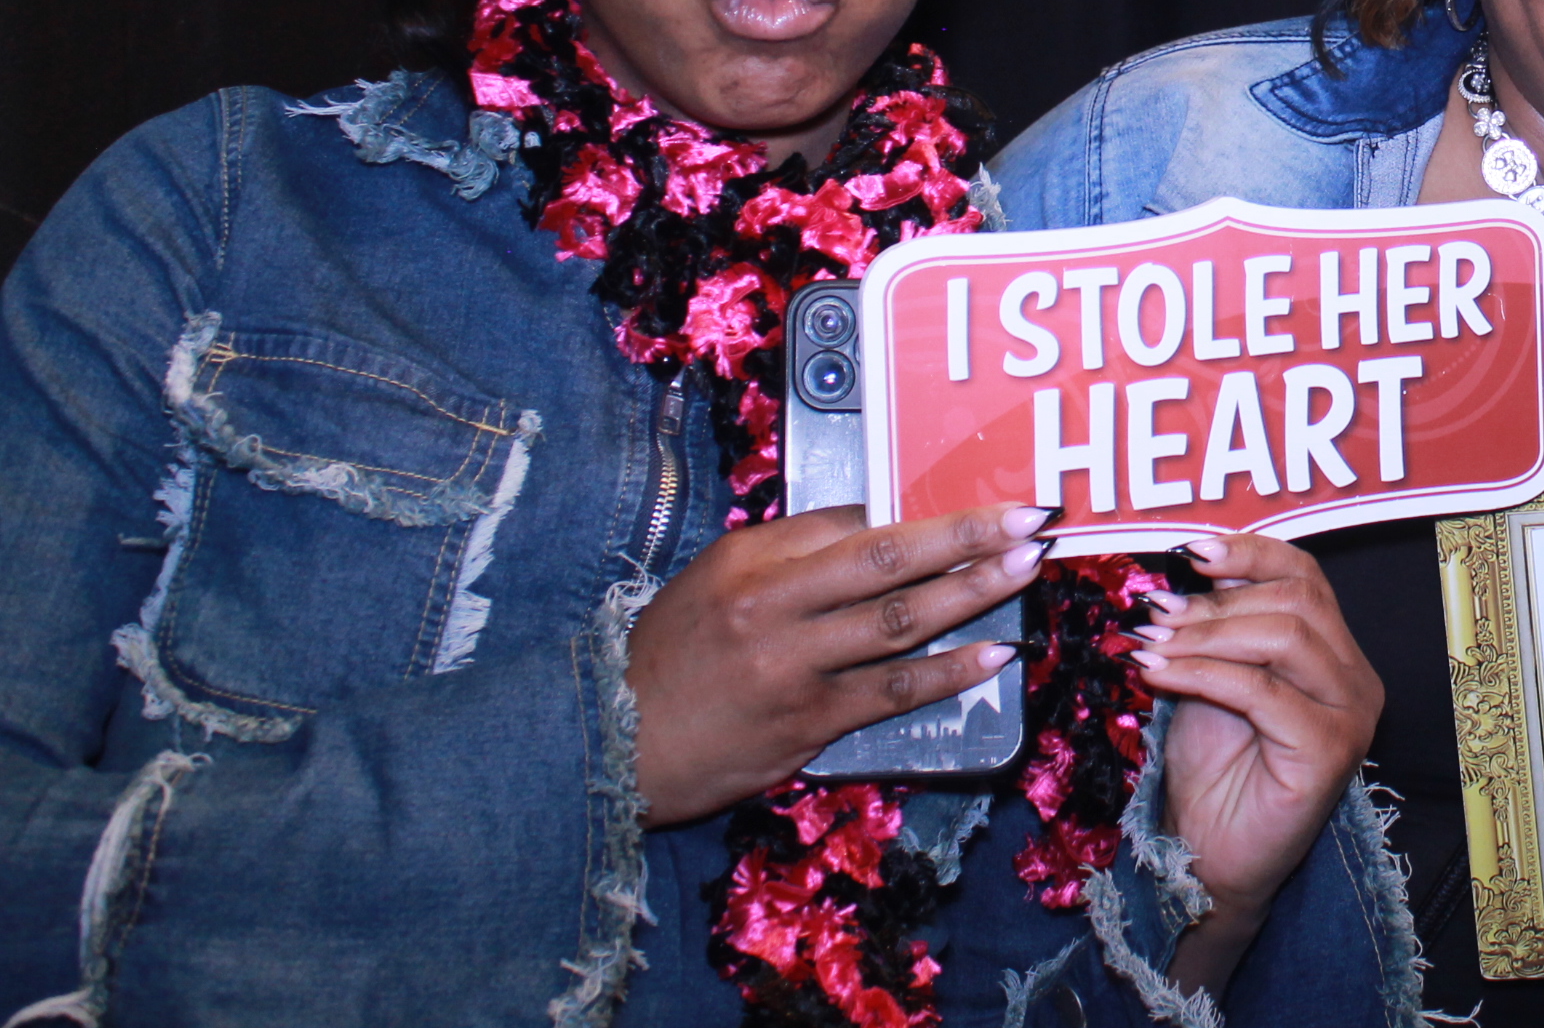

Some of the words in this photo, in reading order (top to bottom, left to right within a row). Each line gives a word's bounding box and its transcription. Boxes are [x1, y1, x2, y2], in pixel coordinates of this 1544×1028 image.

[946, 277, 970, 382] I
[999, 254, 1295, 378] STOLE
[1319, 240, 1494, 350] HER
[1032, 355, 1424, 514] HEART
